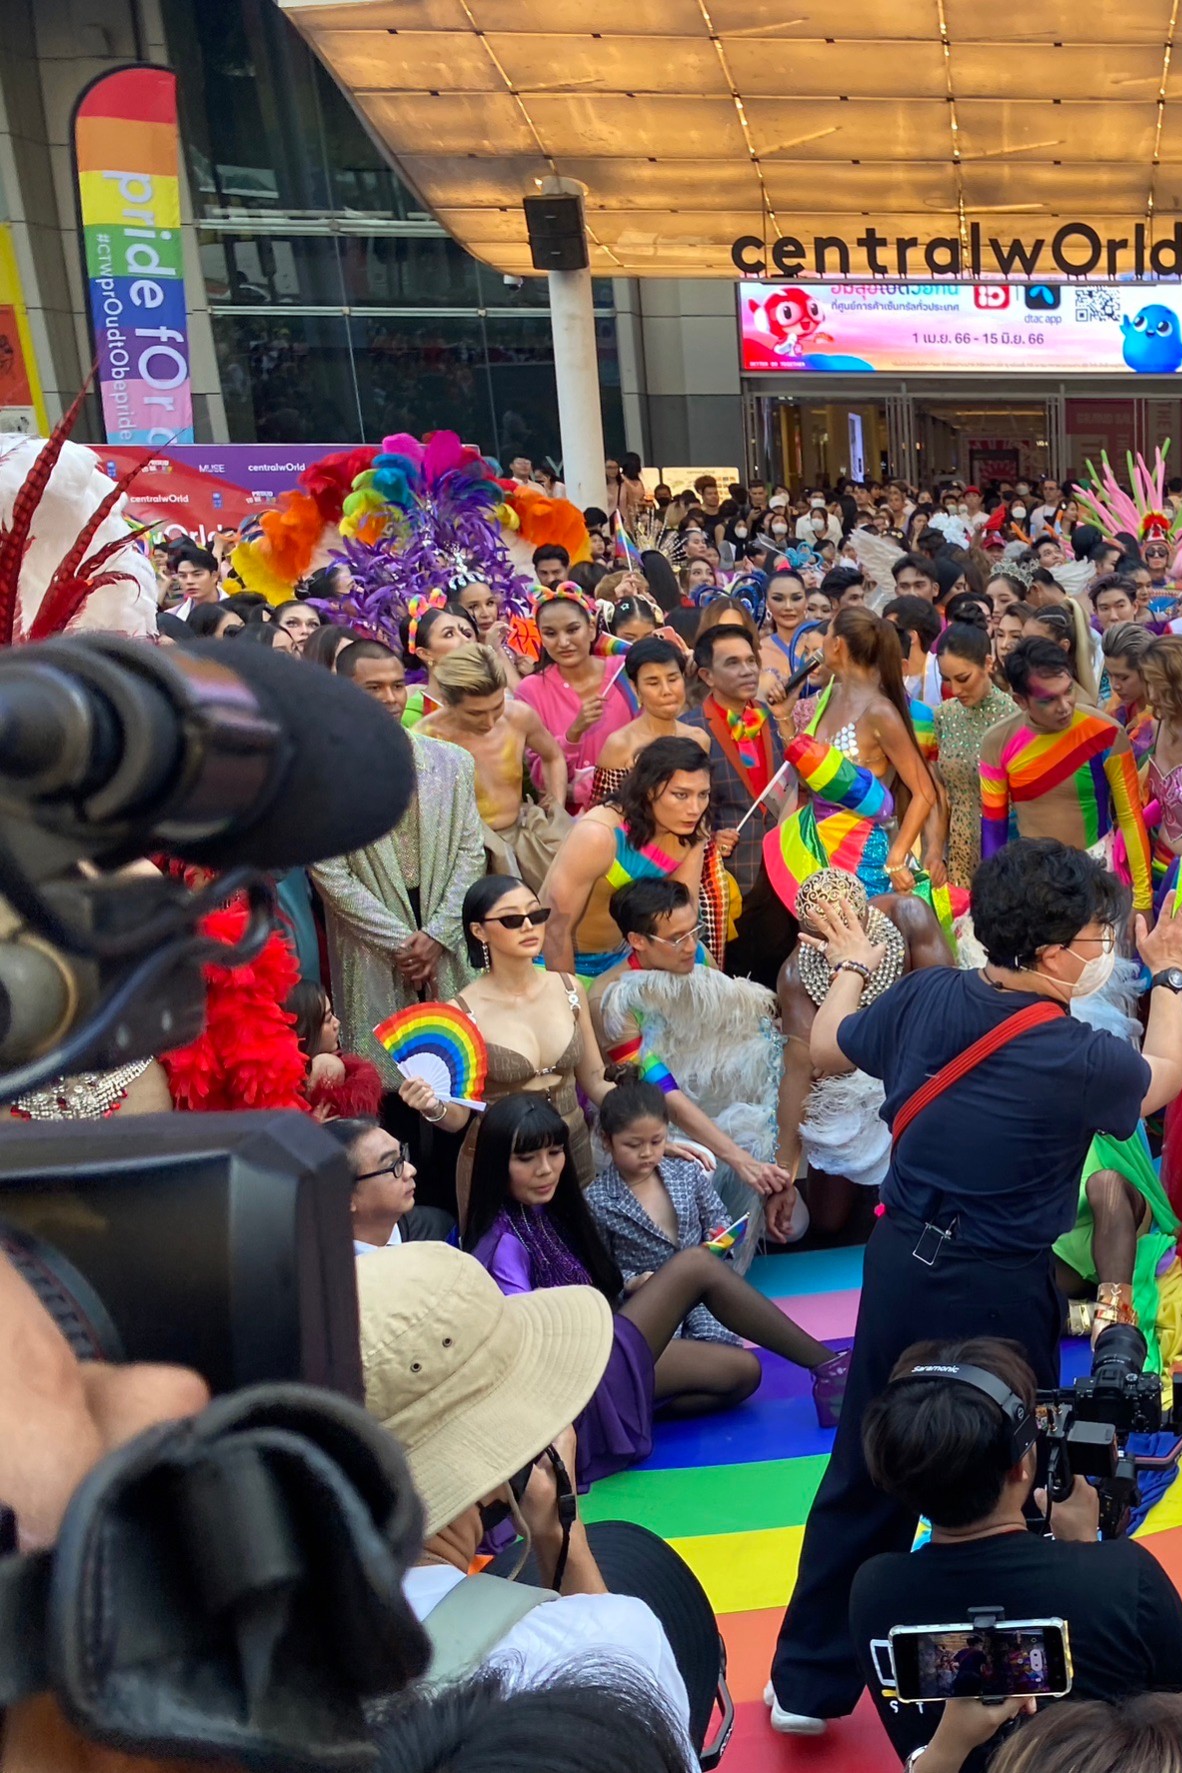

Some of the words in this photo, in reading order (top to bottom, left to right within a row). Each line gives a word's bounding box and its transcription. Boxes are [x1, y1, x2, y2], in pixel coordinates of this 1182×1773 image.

[102, 170, 177, 309] pride
[1024, 313, 1045, 325] dtac
[1047, 315, 1063, 325] app
[954, 333, 971, 344] 66
[982, 333, 998, 345] 15
[1028, 333, 1045, 345] 66
[134, 324, 188, 412] fOr
[248, 463, 306, 472] centralwOrld
[130, 494, 189, 503] centralwOrld
